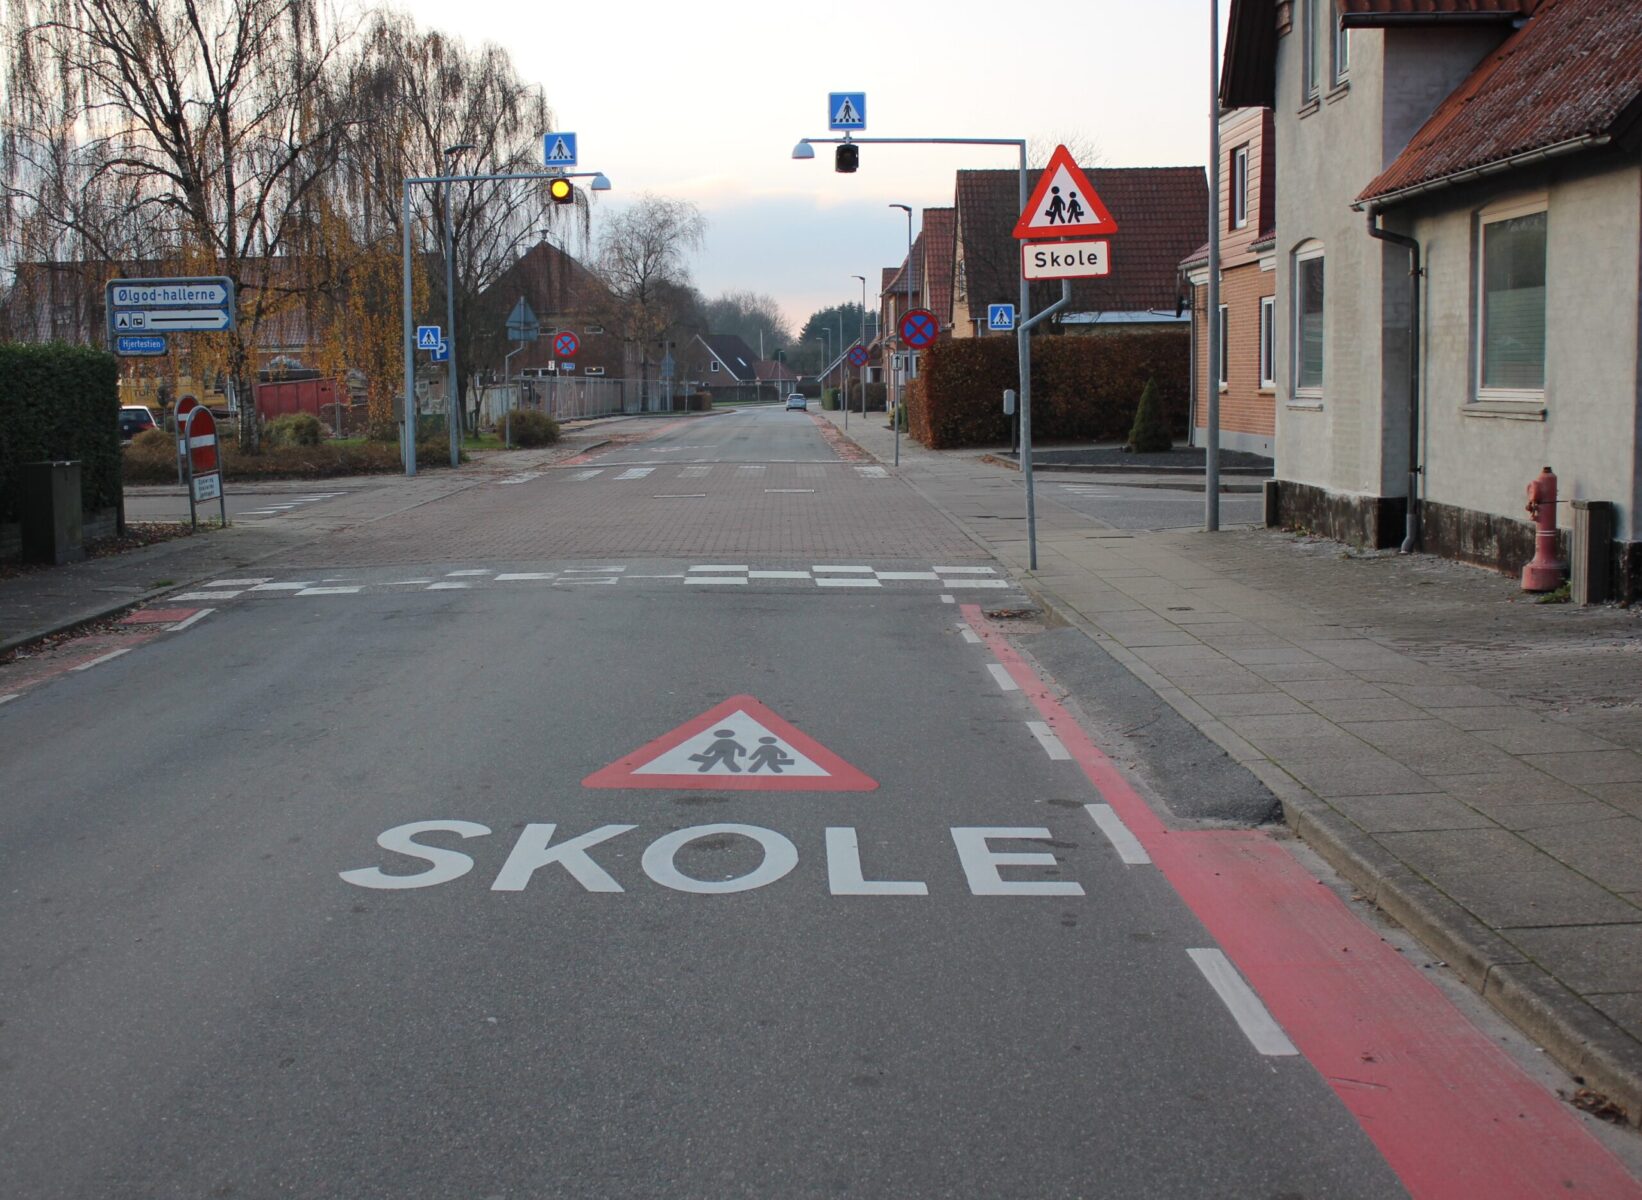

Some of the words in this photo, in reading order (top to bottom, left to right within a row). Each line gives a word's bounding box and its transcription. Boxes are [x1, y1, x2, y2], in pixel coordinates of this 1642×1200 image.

[1034, 249, 1098, 268] Skole
[118, 288, 216, 304] Ølgod-hallerne
[122, 339, 161, 350] Hjertestien
[436, 342, 447, 359] P
[338, 819, 1087, 896] SKOLE
